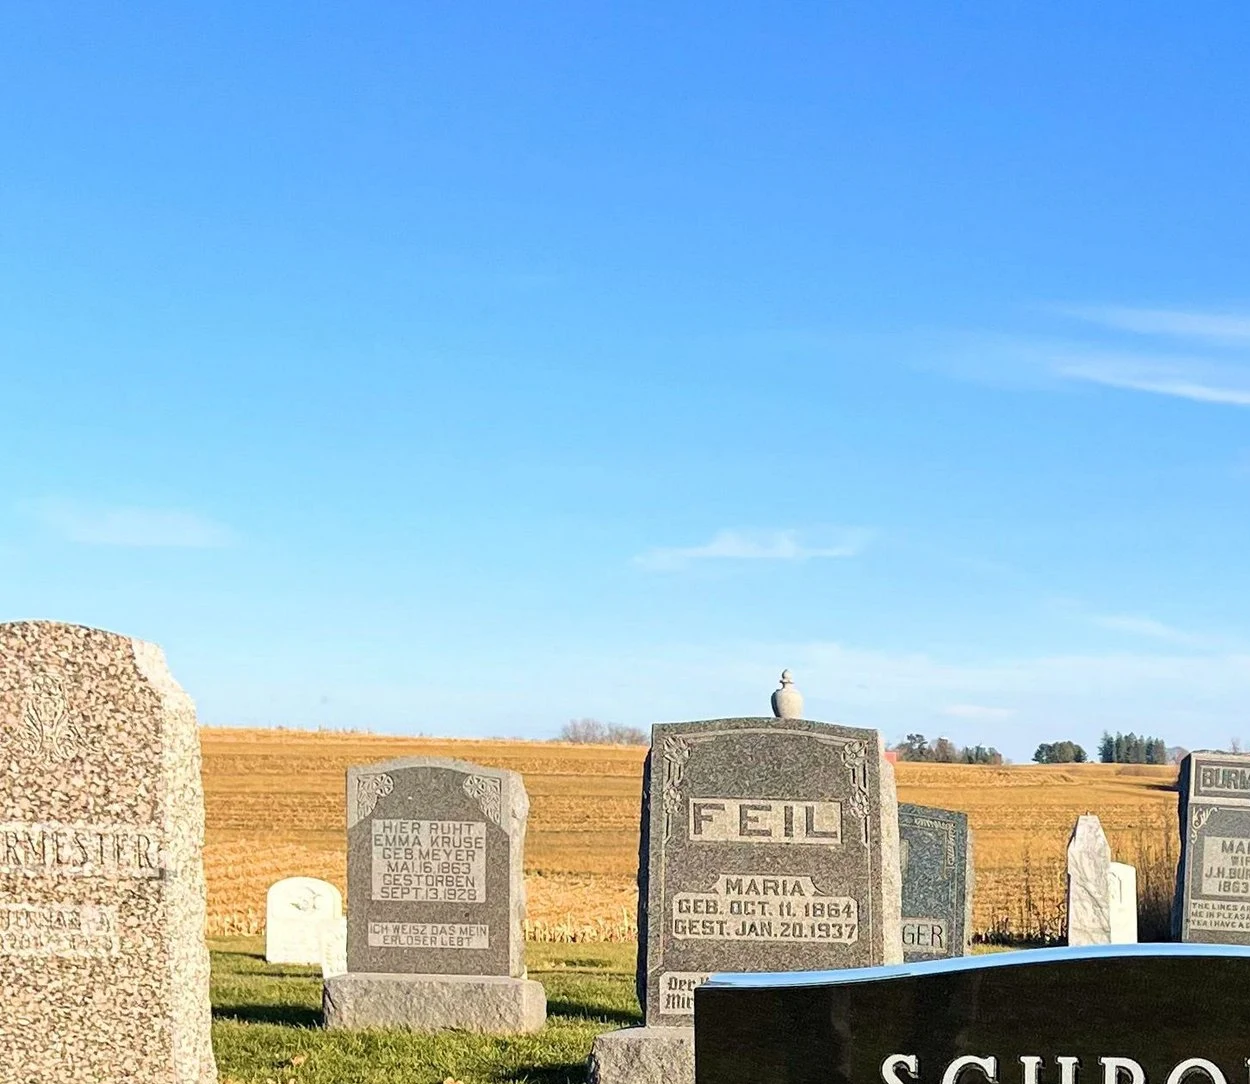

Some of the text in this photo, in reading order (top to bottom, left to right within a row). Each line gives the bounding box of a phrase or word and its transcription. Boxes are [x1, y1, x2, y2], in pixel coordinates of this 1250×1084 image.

[693, 802, 839, 838] FEIL
[383, 822, 474, 835] HIER RUHT
[374, 834, 484, 849] EMMA KRUSE
[383, 873, 475, 887] GESTORBEN
[1218, 880, 1249, 894] 1863
[725, 878, 805, 897] MARIA
[678, 900, 854, 918] GEB. OCT. 11. 1864
[370, 924, 388, 935] ICH
[431, 924, 456, 936] DAS
[459, 925, 487, 936] MEIN
[674, 919, 730, 936] GEST.
[441, 936, 473, 947] LEBT
